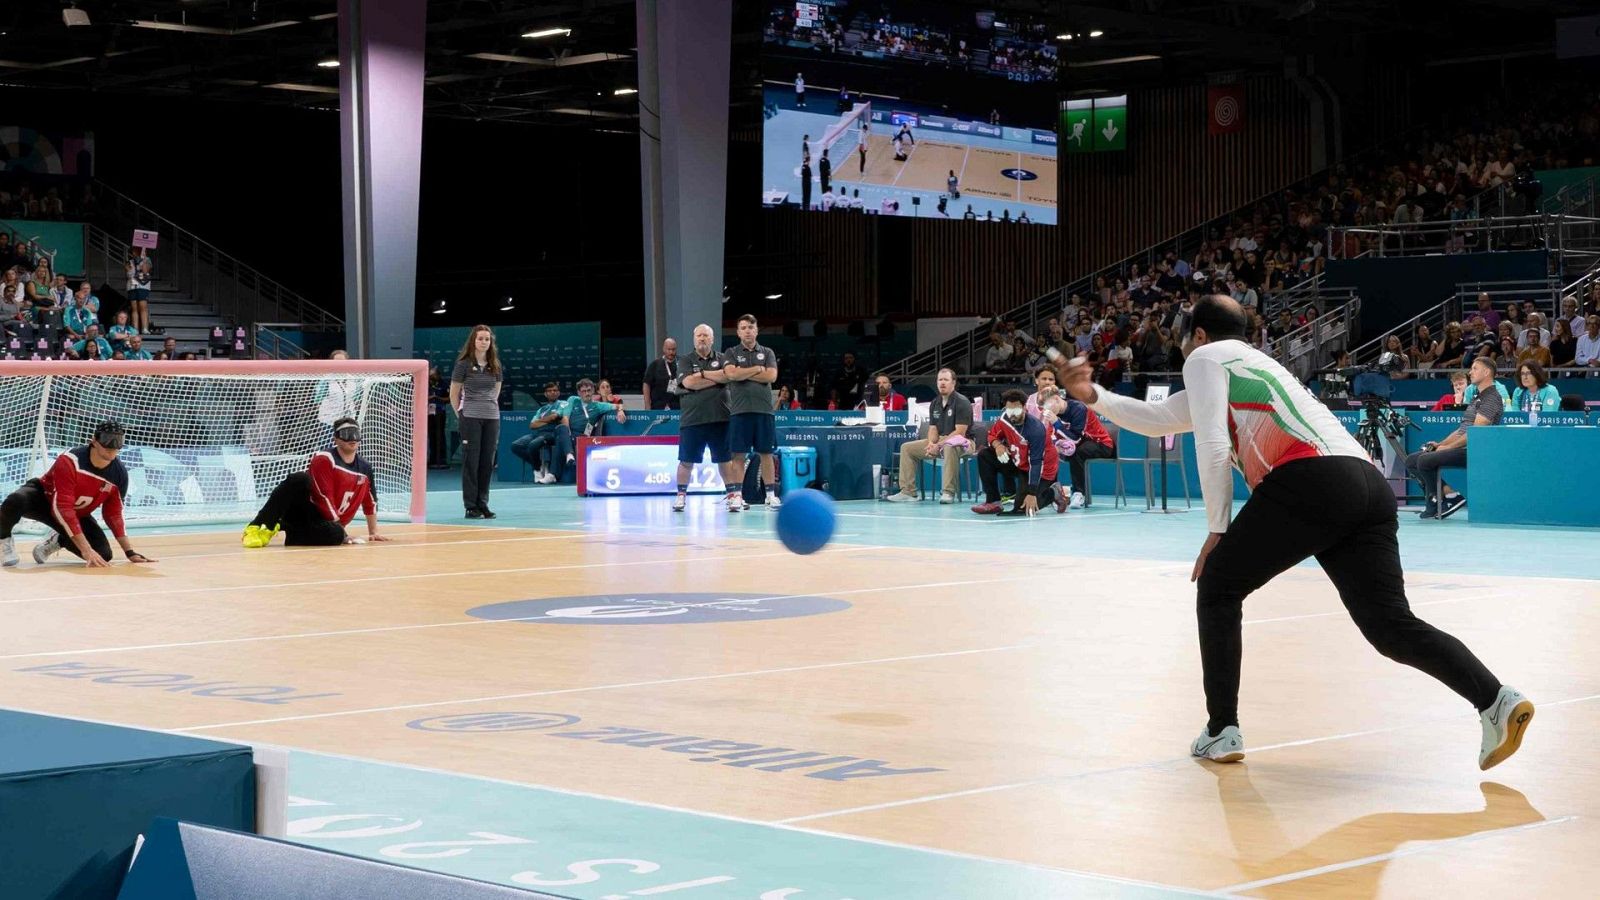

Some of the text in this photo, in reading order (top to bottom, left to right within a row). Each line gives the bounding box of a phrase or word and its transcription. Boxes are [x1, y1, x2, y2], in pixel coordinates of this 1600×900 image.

[1010, 444, 1020, 467] 3
[606, 468, 621, 490] 5
[644, 472, 671, 484] 4:05
[689, 467, 716, 488] 12
[11, 662, 343, 705] TOYOTA
[546, 726, 948, 782] Allianz
